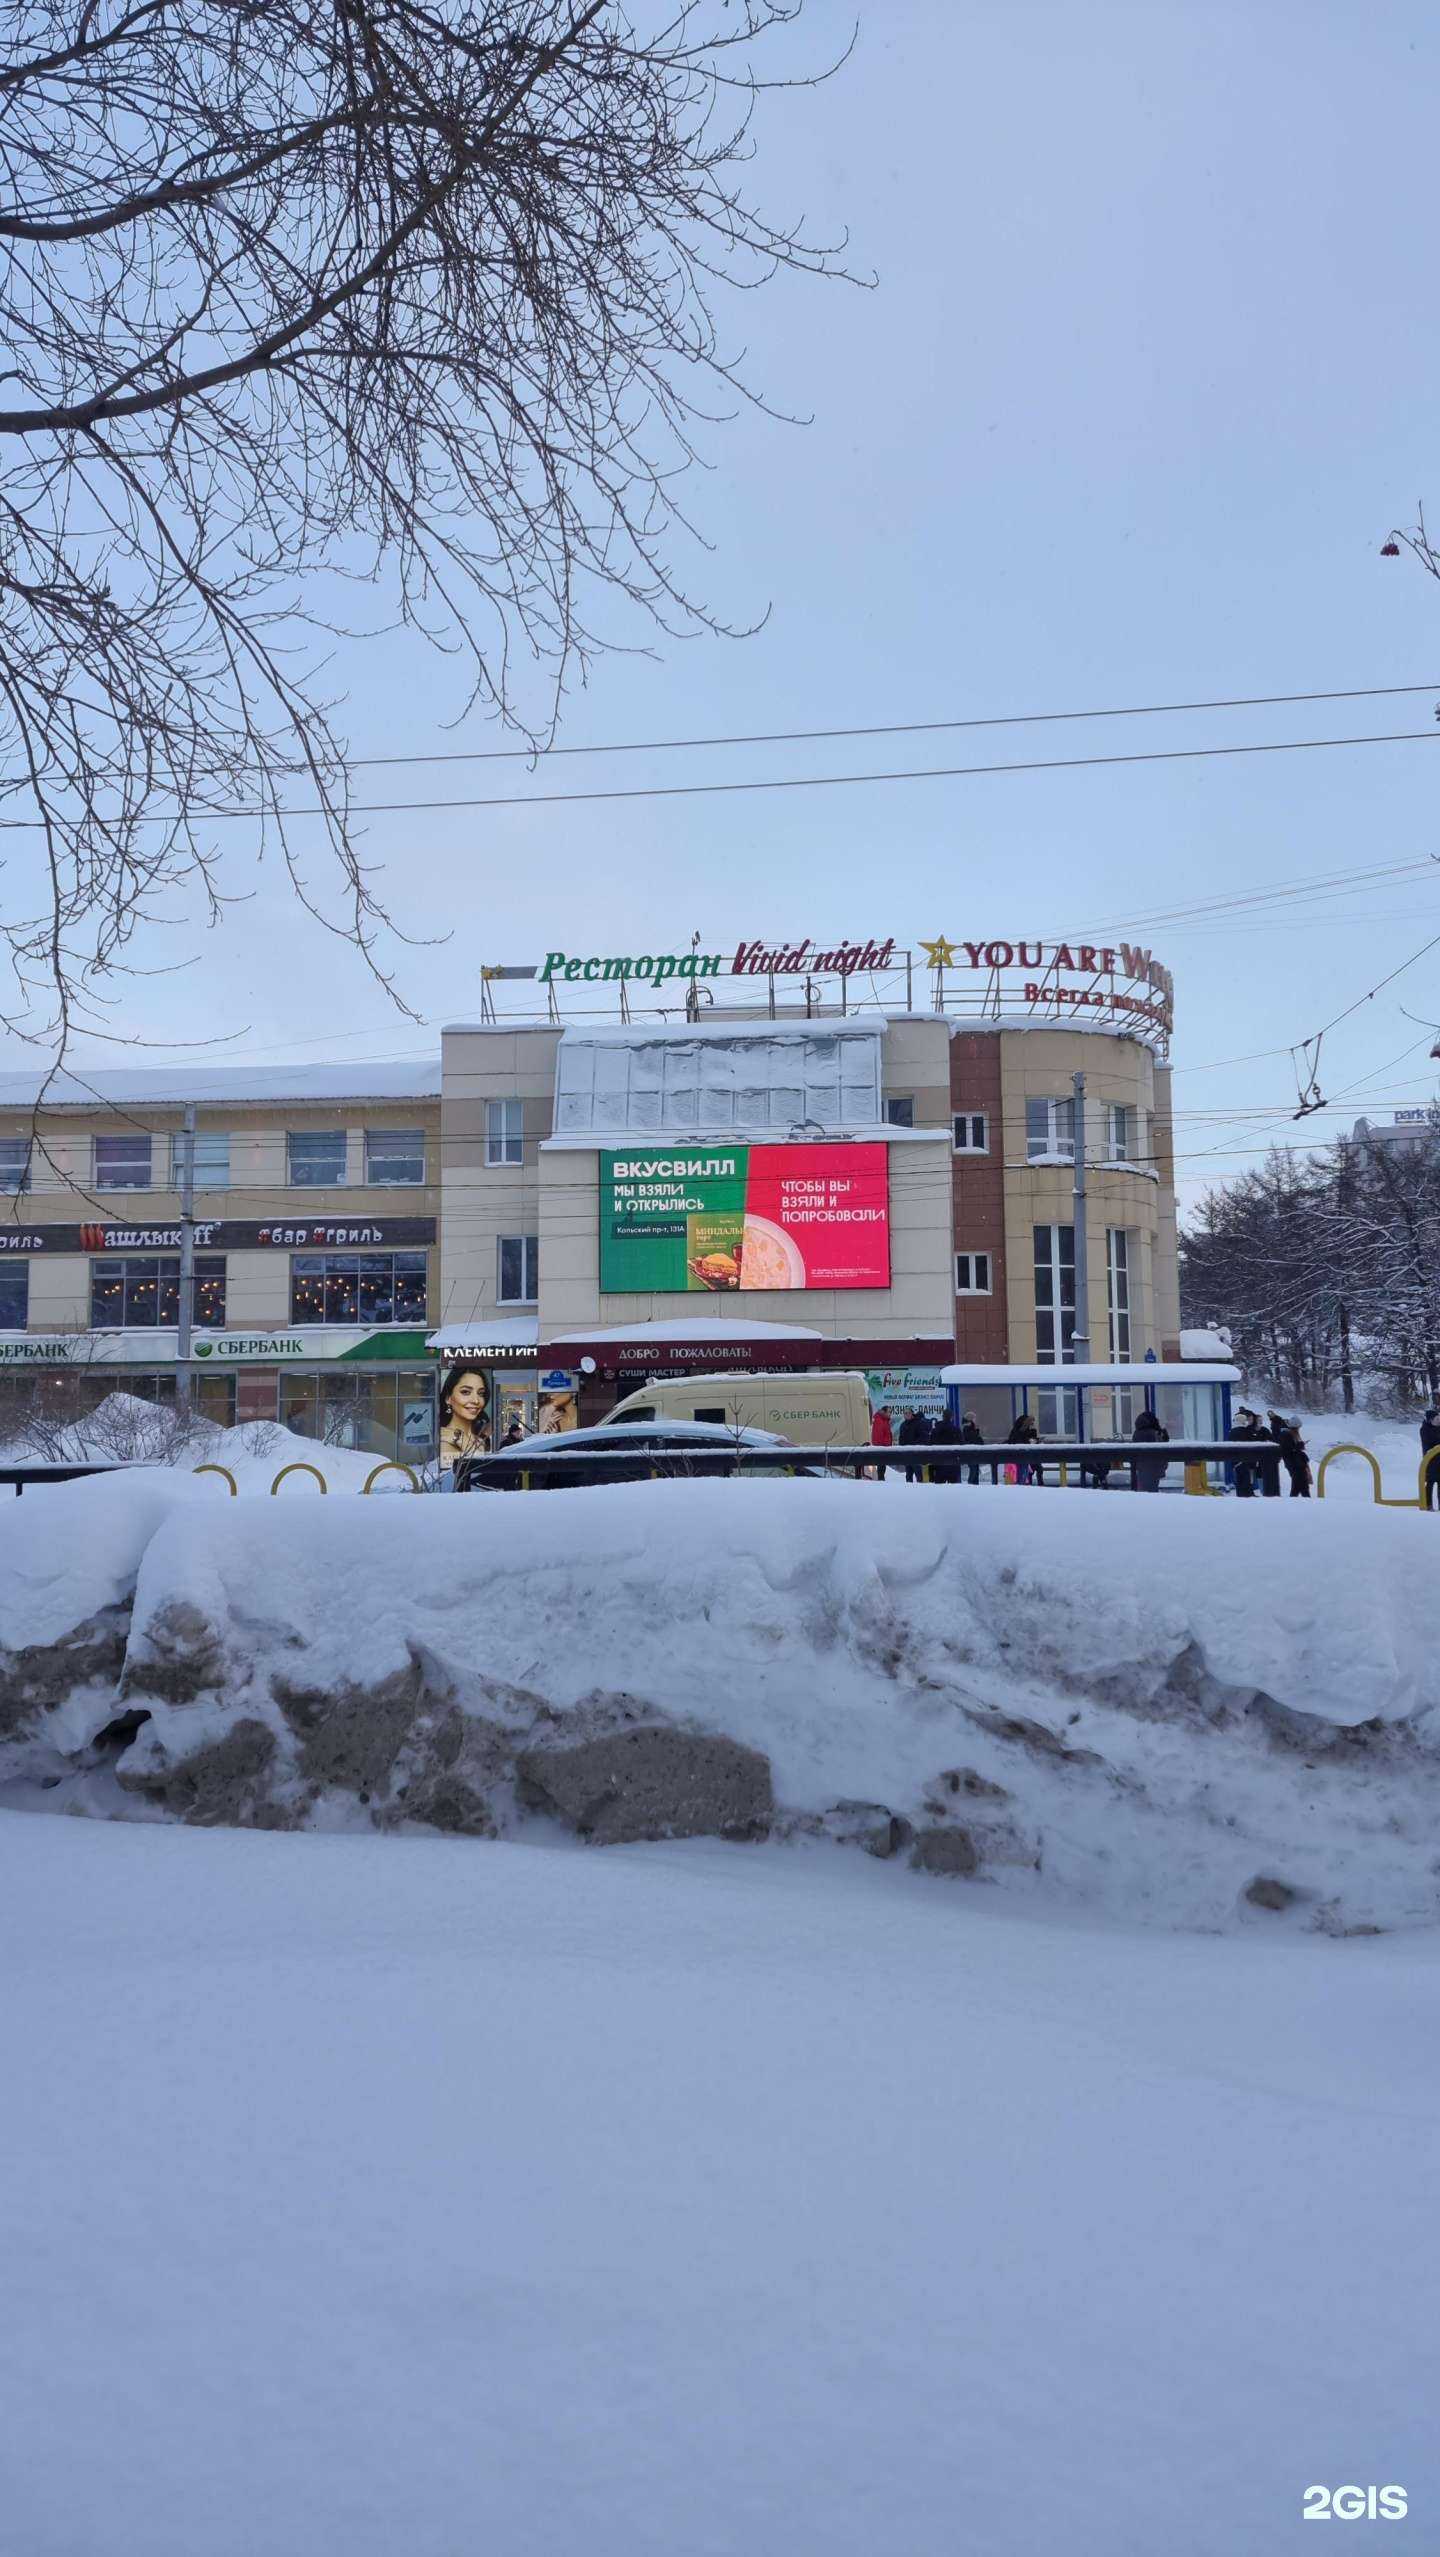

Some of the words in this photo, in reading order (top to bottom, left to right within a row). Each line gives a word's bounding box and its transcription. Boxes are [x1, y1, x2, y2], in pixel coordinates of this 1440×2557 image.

[732, 938, 811, 975] Vivid
[813, 937, 896, 976] night
[963, 940, 1043, 970] YOU
[1052, 943, 1116, 974] ARE
[539, 952, 722, 988] Ресторан
[1024, 982, 1104, 1007] Всегда
[613, 1159, 735, 1178] ВКУСВИЛЛ
[614, 1184, 635, 1197] МЫ
[638, 1184, 684, 1197] ВЗЯЛИ
[781, 1180, 825, 1193] ЧТОБЫ
[829, 1180, 851, 1192] ВЫ
[614, 1200, 622, 1212] И
[626, 1198, 705, 1212] ОТКРЫЛИСЬ
[781, 1196, 825, 1208] ВЗЯЛИ
[829, 1196, 837, 1208] И
[781, 1209, 886, 1223] ПОПРОБОВАЛИ
[80, 1223, 215, 1251] Шашлыкff
[272, 1228, 308, 1245] бар
[326, 1227, 384, 1245] гриль
[617, 1226, 651, 1234] Кольский
[217, 1339, 304, 1355] СБЕРБАНК
[443, 1346, 538, 1358] КЛЕМЕНТИН
[619, 1349, 660, 1360] ДОБРО
[669, 1347, 752, 1359] ПОЖАЛОВАТЬ!
[619, 1369, 646, 1377] СУШИ
[649, 1368, 686, 1377] МАСТЕР
[783, 1410, 841, 1420] СБЕРБАНК
